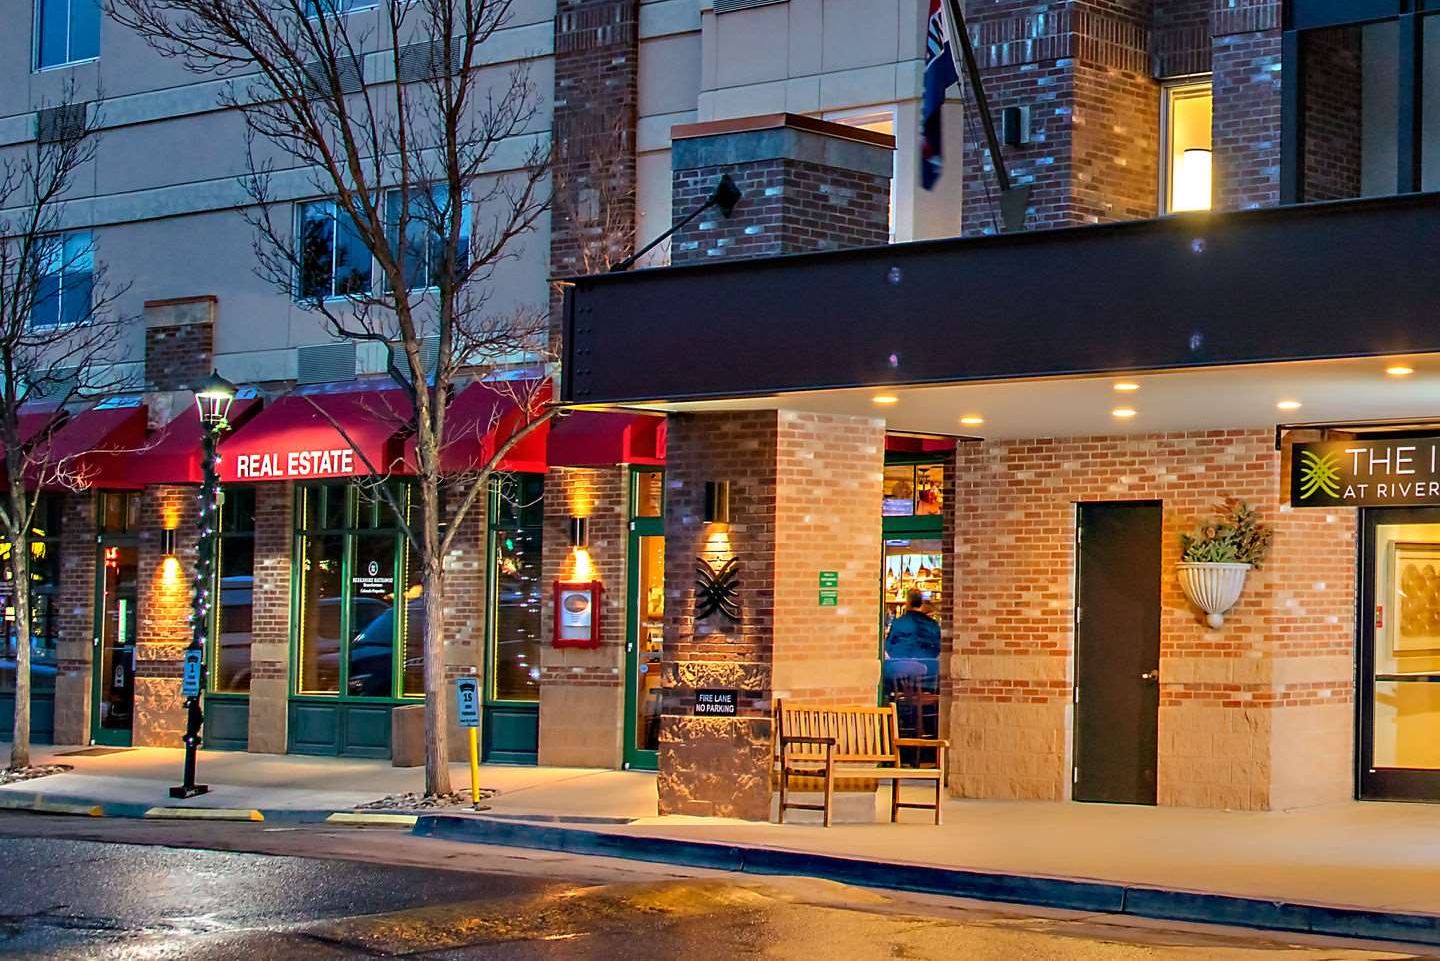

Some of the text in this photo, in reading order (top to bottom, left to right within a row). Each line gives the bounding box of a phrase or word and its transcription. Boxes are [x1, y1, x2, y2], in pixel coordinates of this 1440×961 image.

[237, 449, 354, 478] REAL ESTATE
[1344, 446, 1416, 476] THE
[1343, 484, 1369, 499] AT
[463, 693, 472, 702] 15
[699, 694, 713, 702] FIRE
